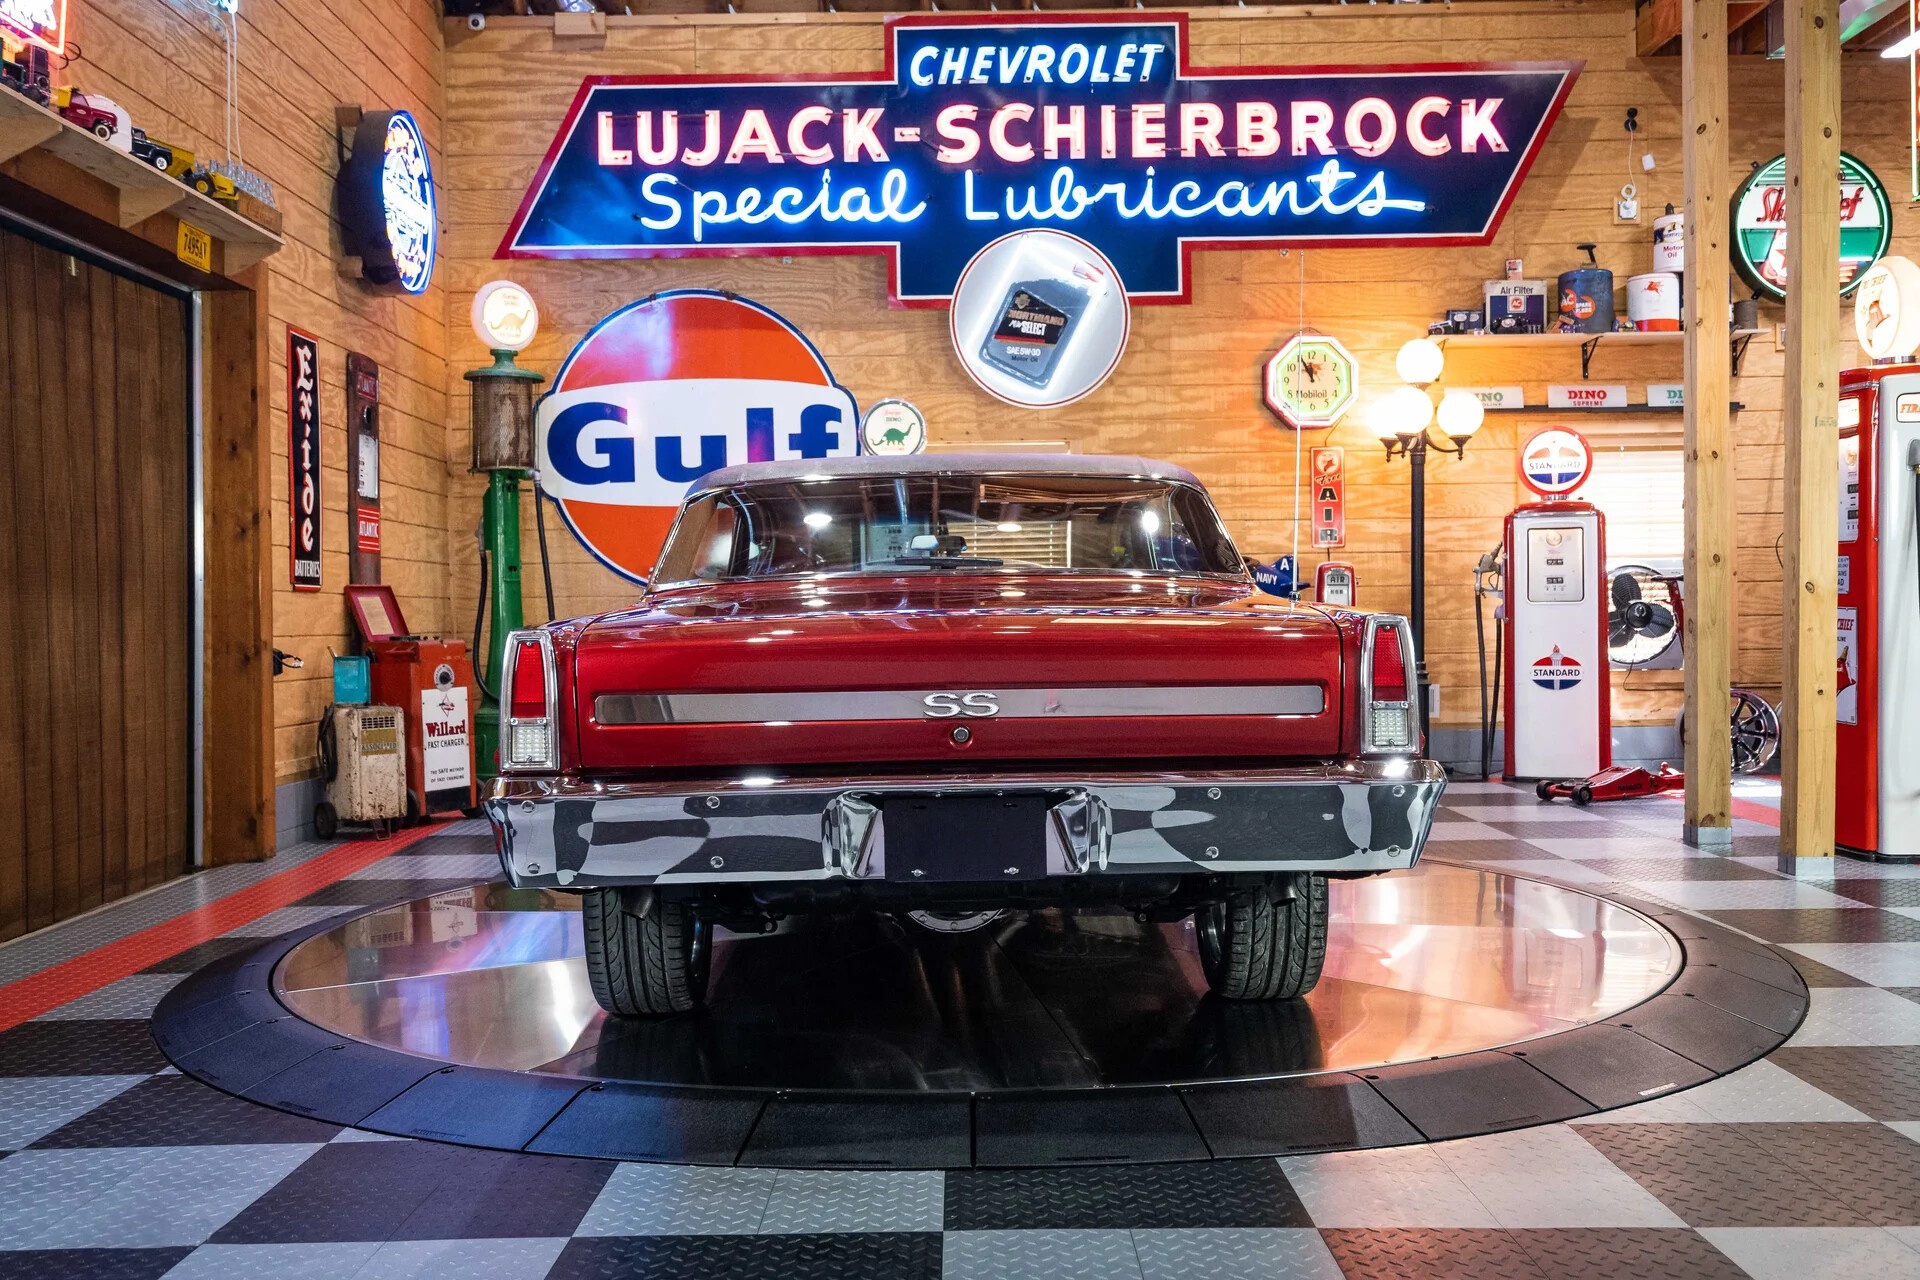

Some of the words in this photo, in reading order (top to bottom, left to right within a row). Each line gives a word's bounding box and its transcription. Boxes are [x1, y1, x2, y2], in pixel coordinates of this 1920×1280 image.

[909, 44, 1164, 88] CHEVROLET
[597, 97, 1509, 166] LUJACK-SCHIERBROCK
[639, 168, 927, 241] Special
[964, 159, 1427, 221] Lubricants
[1500, 286, 1511, 295] Air
[1513, 286, 1534, 294] Filter
[1561, 292, 1575, 307] AC
[1021, 321, 1046, 335] SELECT
[1006, 346, 1020, 355] SAE
[1307, 351, 1317, 360] 12
[1286, 363, 1296, 372] 10
[1296, 389, 1328, 399] Mobiloil
[1567, 389, 1608, 400] DINO
[1666, 389, 1684, 399] DI
[296, 345, 314, 551] Exide
[547, 403, 842, 485] Gulf
[1319, 487, 1338, 542] AIR
[294, 559, 320, 578] BATTERIES
[1280, 557, 1290, 571] A
[1256, 571, 1278, 585] NAVY
[922, 692, 1000, 718] SS
[425, 720, 466, 737] Willard
[427, 740, 440, 750] FAST
[440, 738, 465, 749] CHARGER
